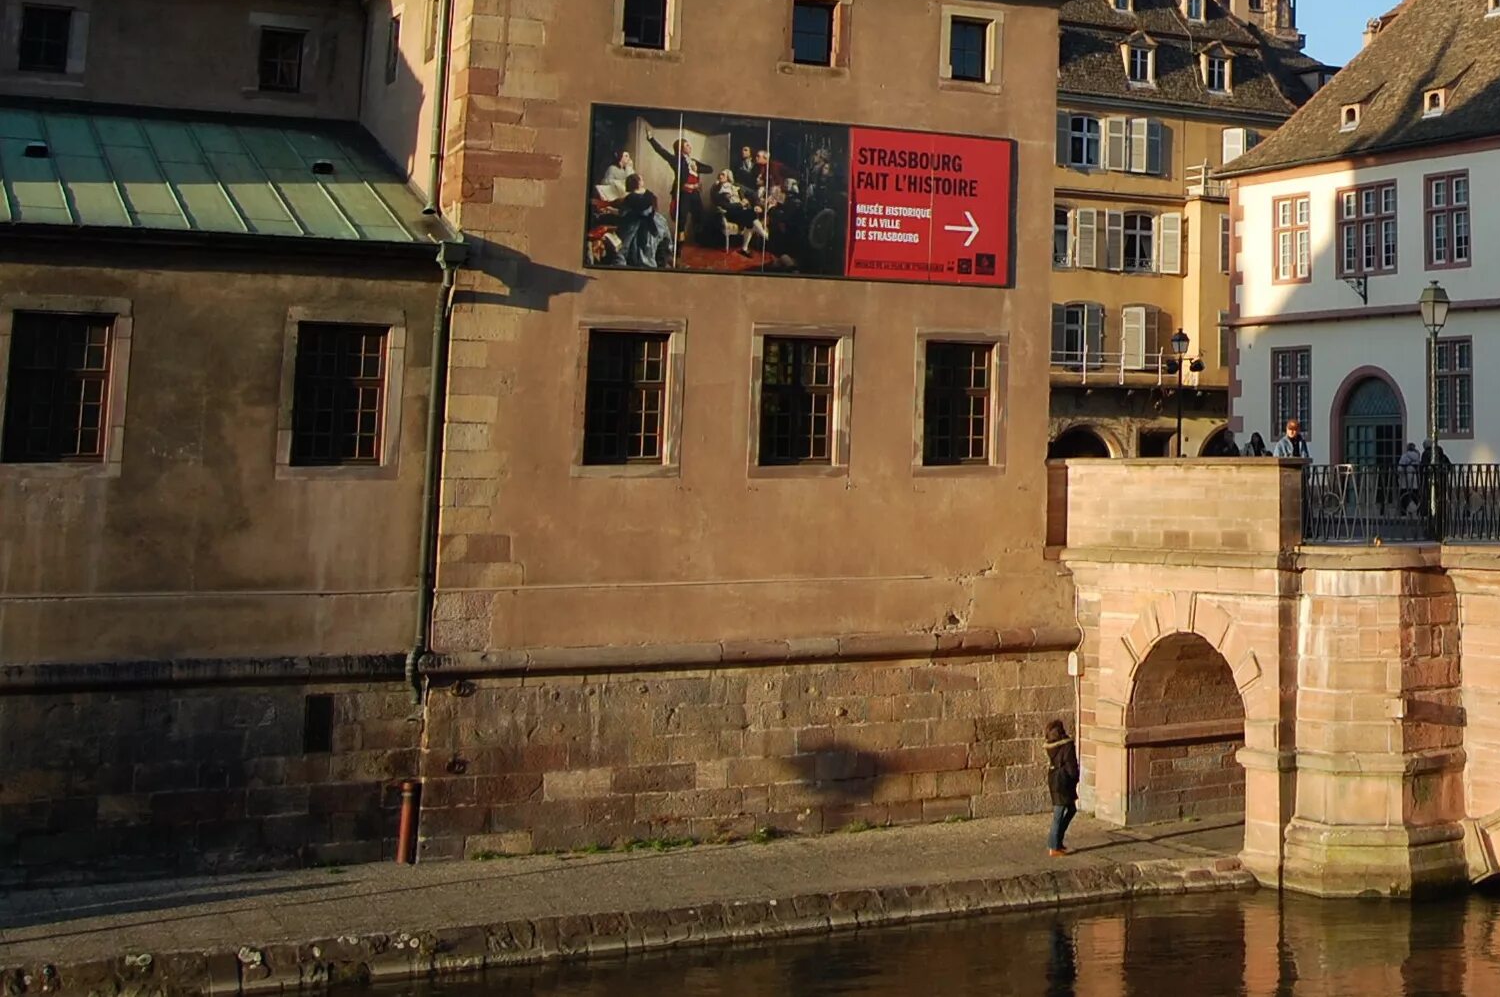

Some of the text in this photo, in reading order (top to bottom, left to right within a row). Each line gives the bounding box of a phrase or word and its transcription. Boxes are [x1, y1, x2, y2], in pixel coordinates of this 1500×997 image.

[858, 147, 962, 172] STRASBOURG
[857, 171, 978, 197] FAIT L'HISTOIRE
[856, 203, 932, 219] MUSÉE HISTORIQUE
[856, 217, 900, 229] DE LA VILLE
[855, 230, 919, 243] DE STRASBOURG
